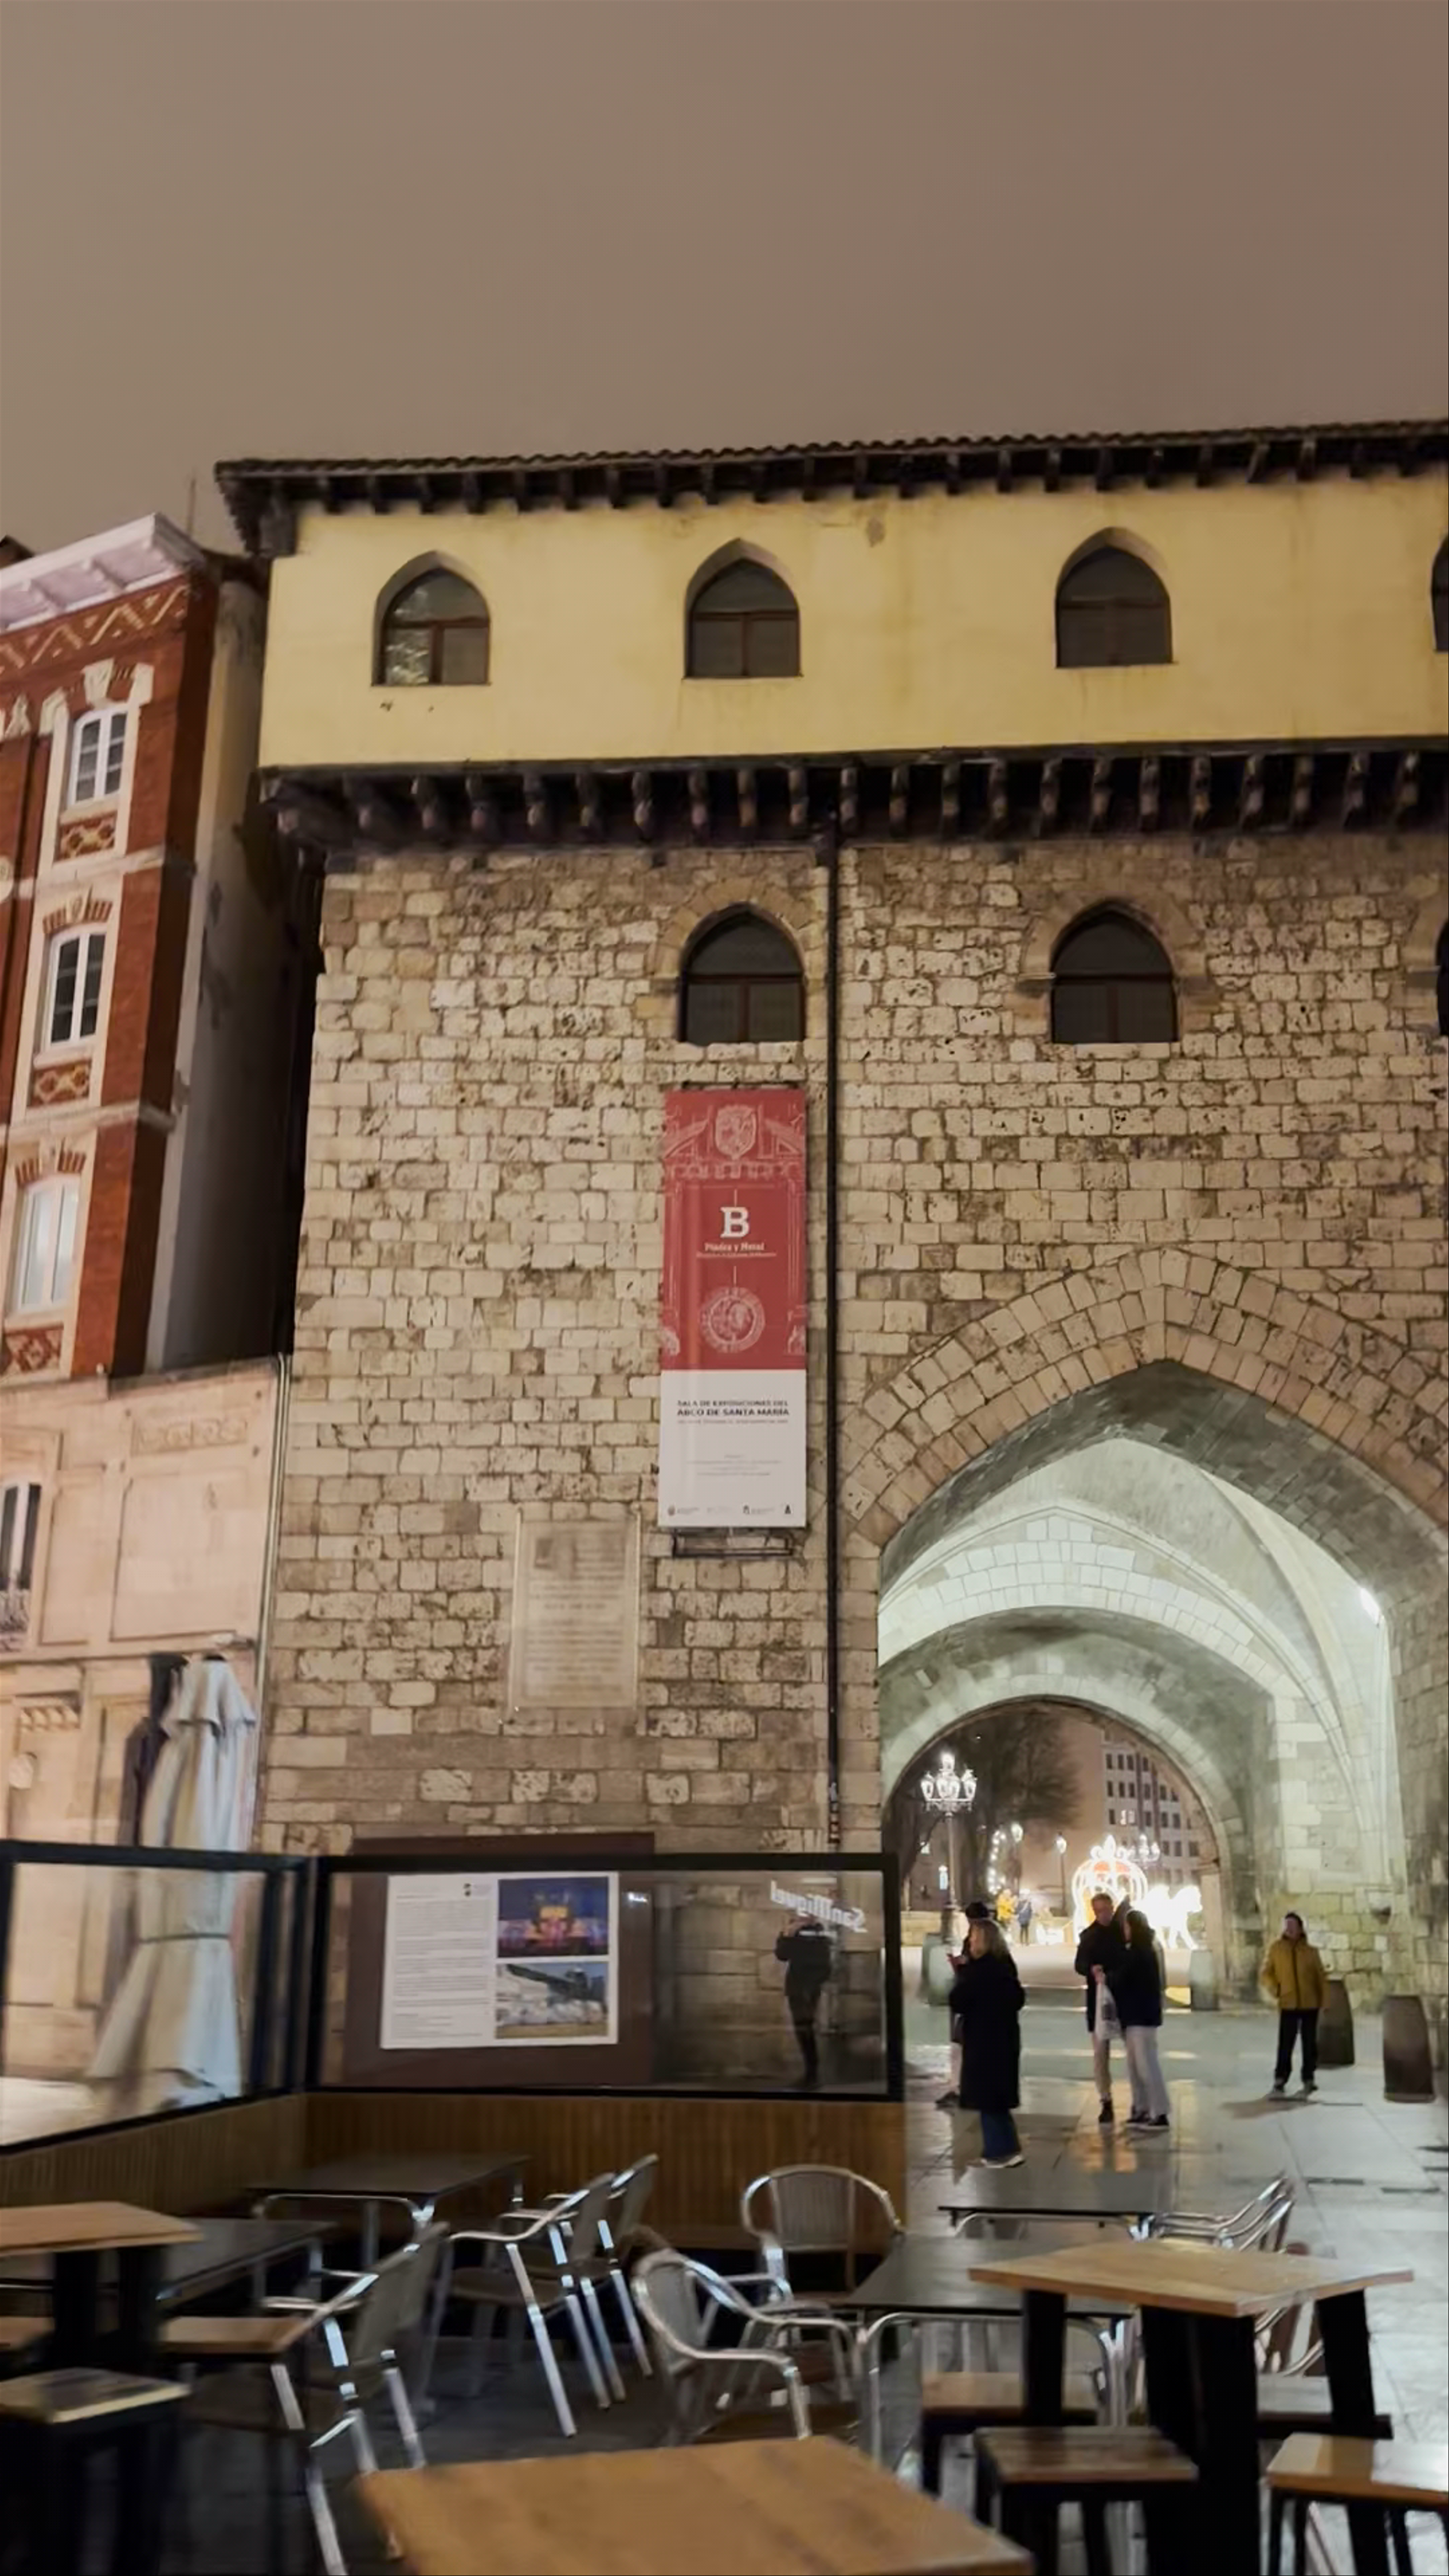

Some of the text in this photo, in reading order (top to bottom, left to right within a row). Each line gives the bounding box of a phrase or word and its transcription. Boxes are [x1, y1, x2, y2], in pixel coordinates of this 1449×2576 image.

[720, 1207, 749, 1238] B
[677, 1408, 704, 1416] ARCO
[706, 1408, 718, 1416] DE
